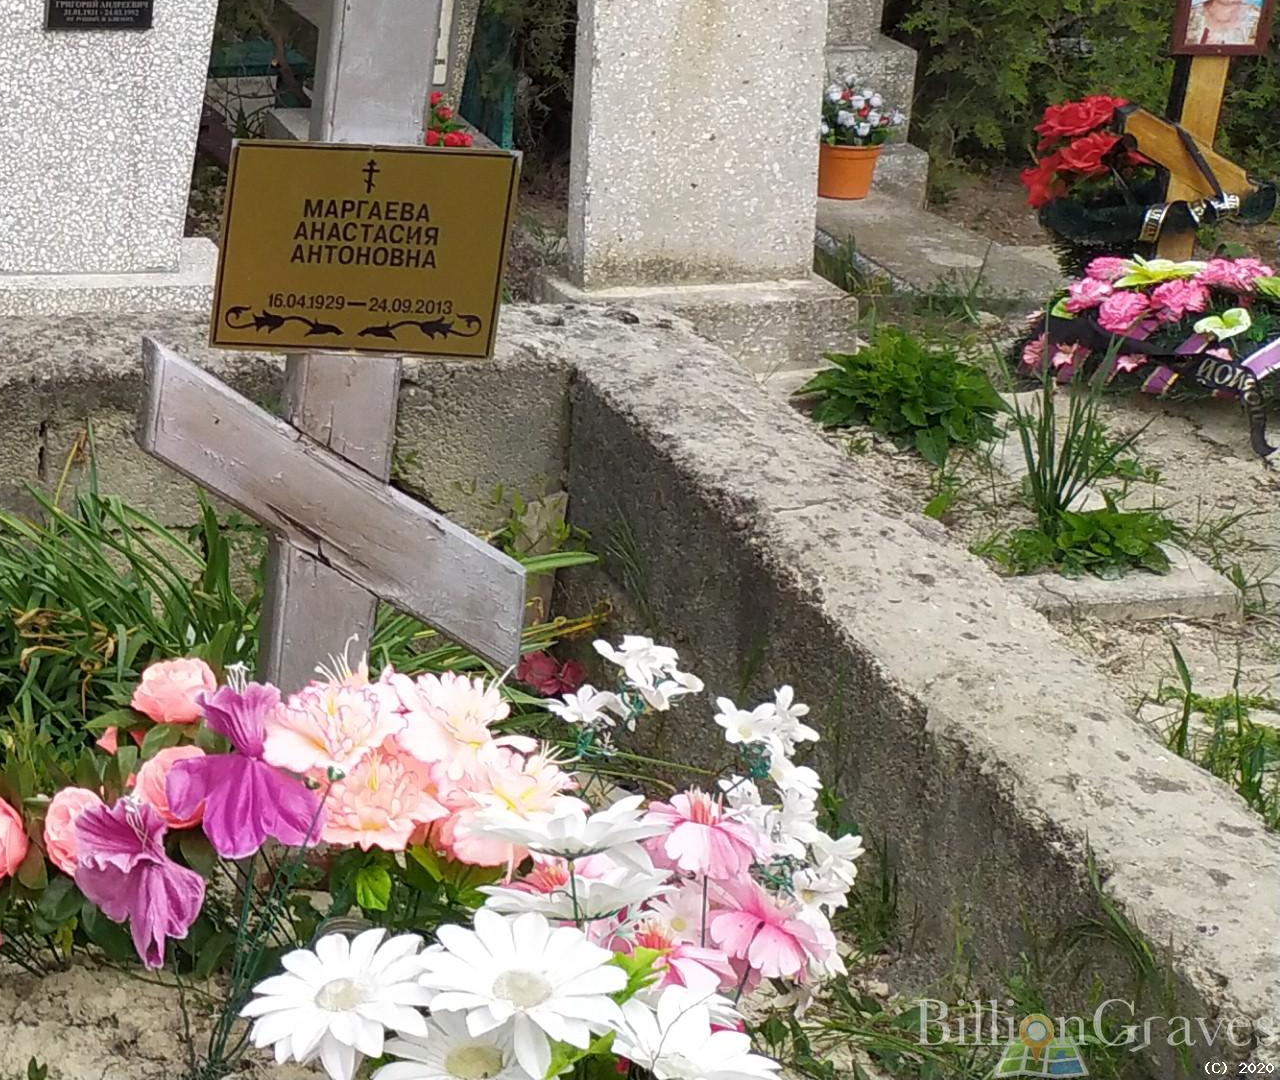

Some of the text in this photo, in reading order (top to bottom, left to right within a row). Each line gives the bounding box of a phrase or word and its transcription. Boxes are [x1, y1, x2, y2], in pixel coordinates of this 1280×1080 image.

[303, 199, 431, 223] МАРГАЕВА
[293, 221, 440, 247] АНАСТАСИЯ
[290, 244, 438, 269] АНТОНОВНА
